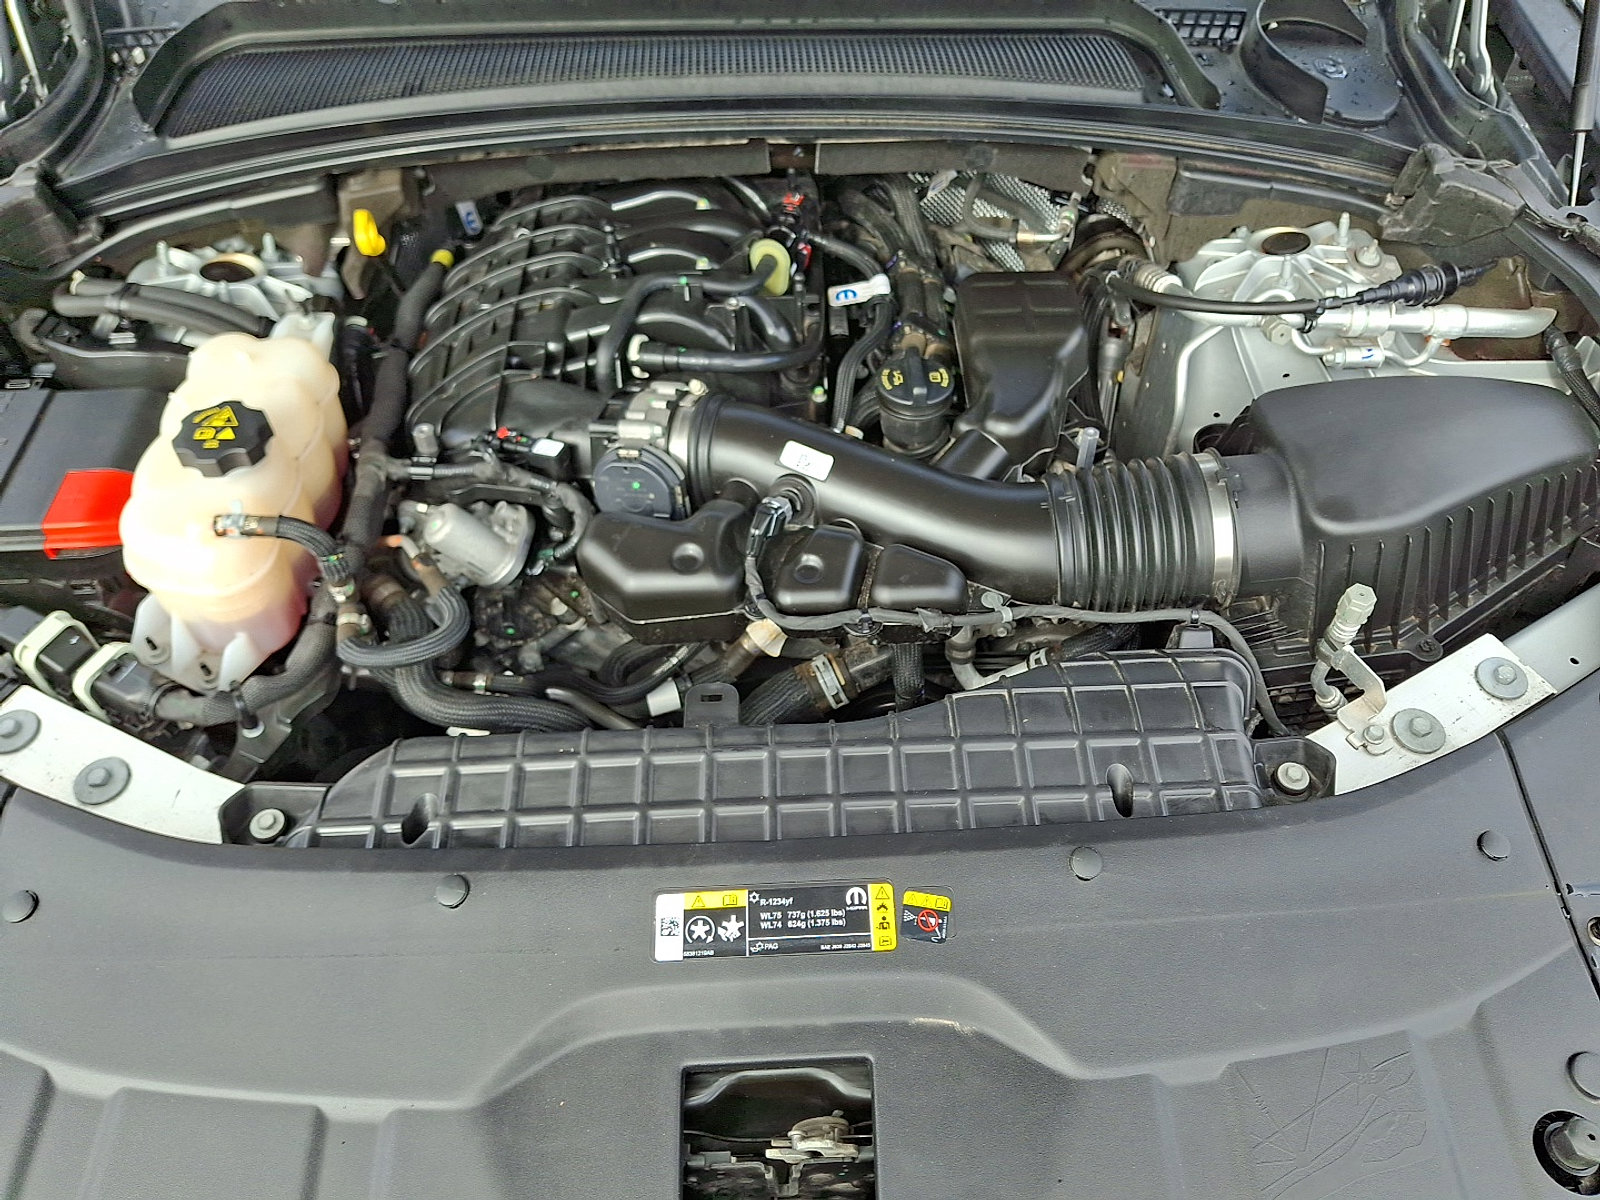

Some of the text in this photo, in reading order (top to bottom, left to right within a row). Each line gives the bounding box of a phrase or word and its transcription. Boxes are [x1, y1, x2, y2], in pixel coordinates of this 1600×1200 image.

[760, 897, 794, 906] R-1234yf
[760, 912, 782, 920] WL75
[787, 911, 806, 919] 737g
[831, 909, 846, 918] lbs)
[760, 921, 782, 929] WL74
[831, 918, 846, 927] lbs)
